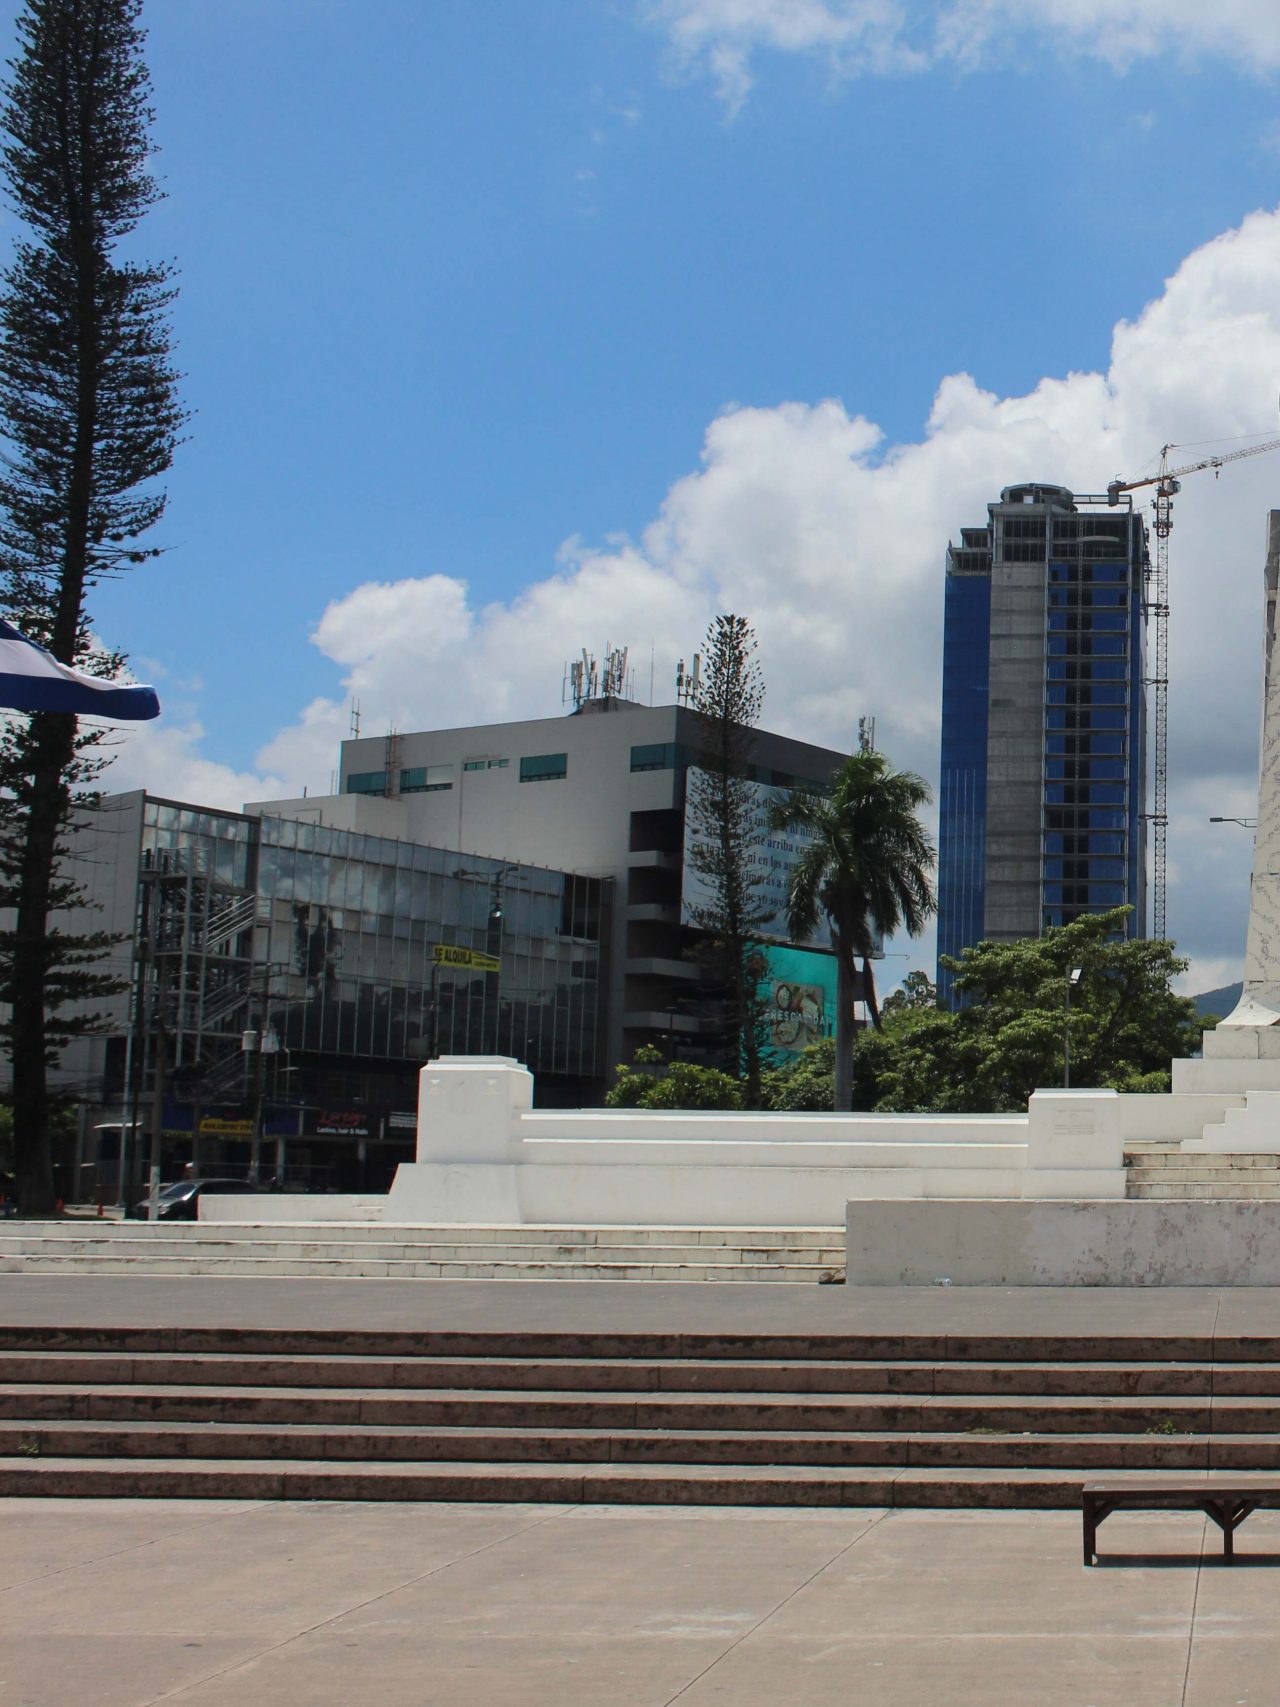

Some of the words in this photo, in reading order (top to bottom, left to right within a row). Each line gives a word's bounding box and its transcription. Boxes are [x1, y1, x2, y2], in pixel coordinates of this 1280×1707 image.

[768, 837, 793, 853] arriba
[748, 851, 756, 864] ni
[758, 855, 768, 867] en
[435, 947, 444, 961] SE
[445, 948, 472, 964] ALQUILA
